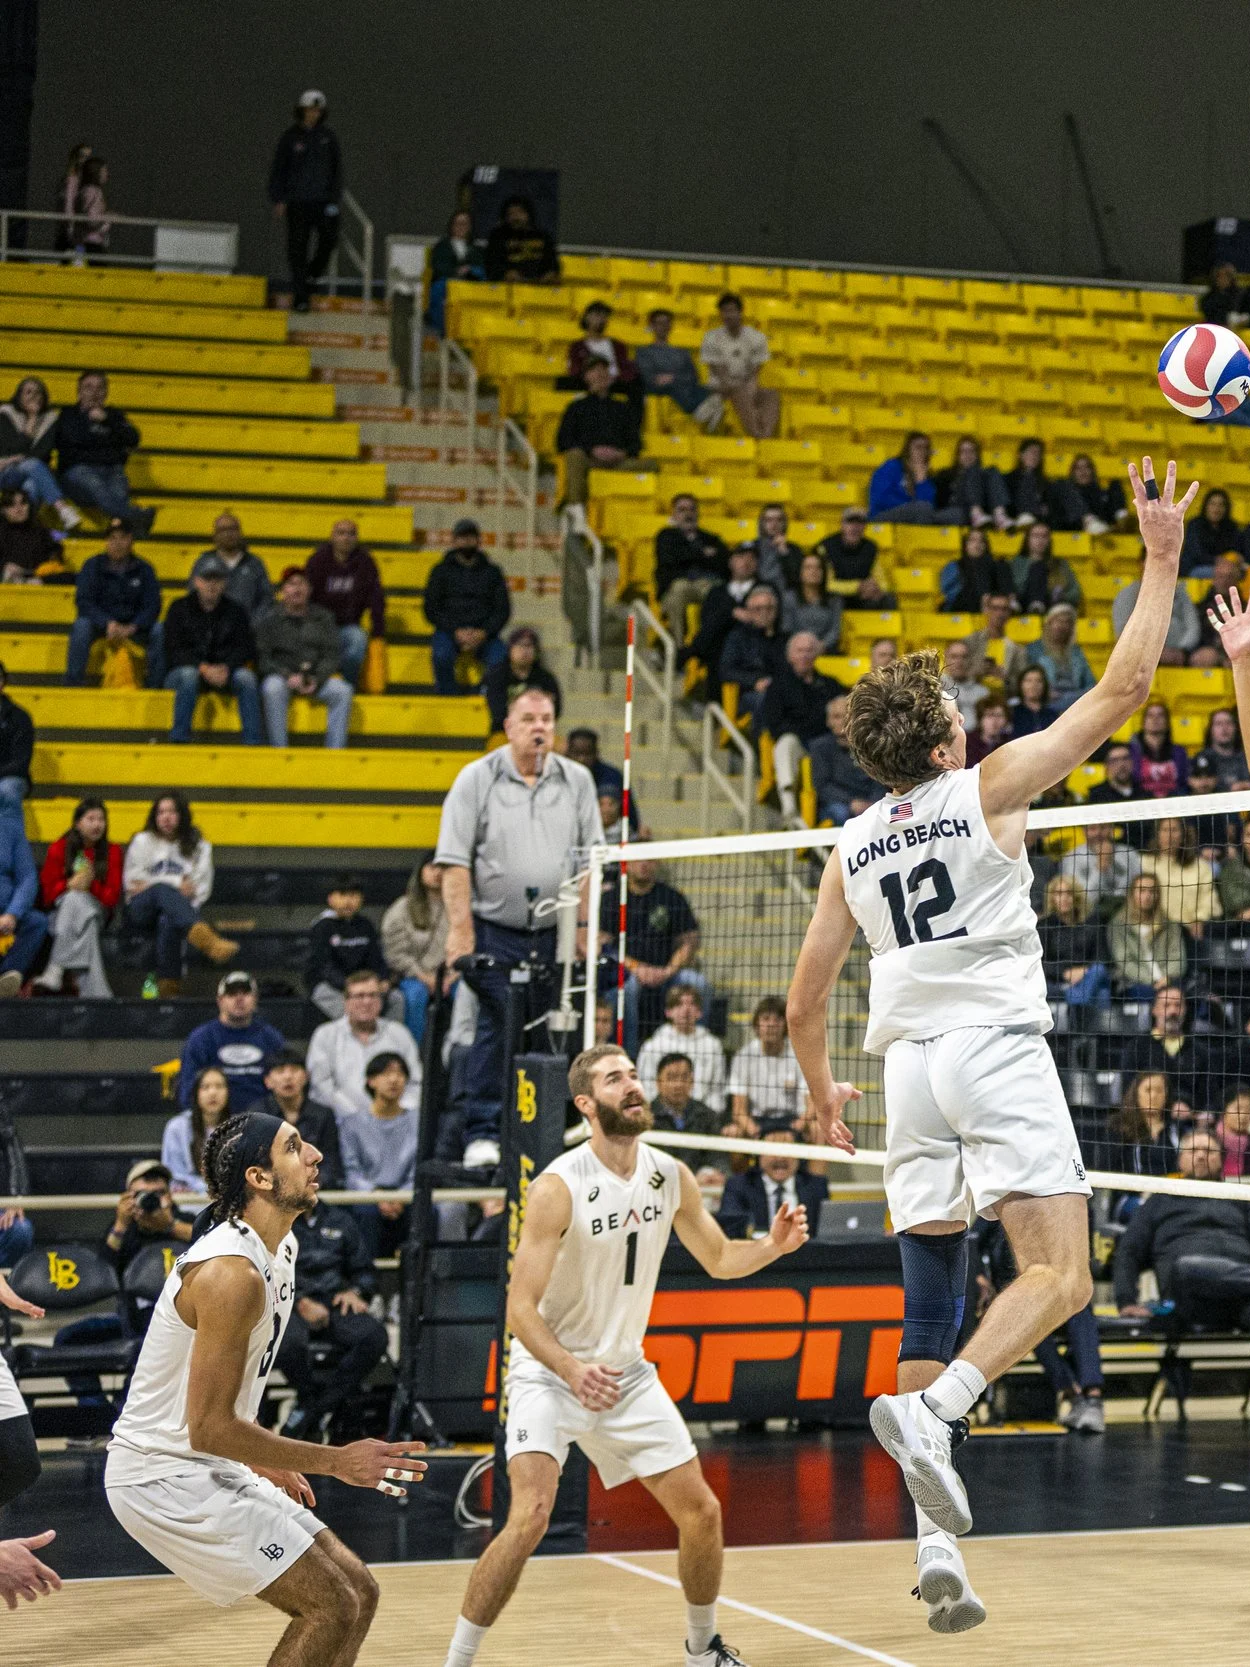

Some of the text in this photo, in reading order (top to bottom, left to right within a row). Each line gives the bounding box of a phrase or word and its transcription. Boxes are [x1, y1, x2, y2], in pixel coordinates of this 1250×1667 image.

[847, 819, 971, 877] LONG BEACH
[879, 858, 968, 948] 12
[592, 1205, 662, 1236] BEACH
[624, 1231, 638, 1286] 1
